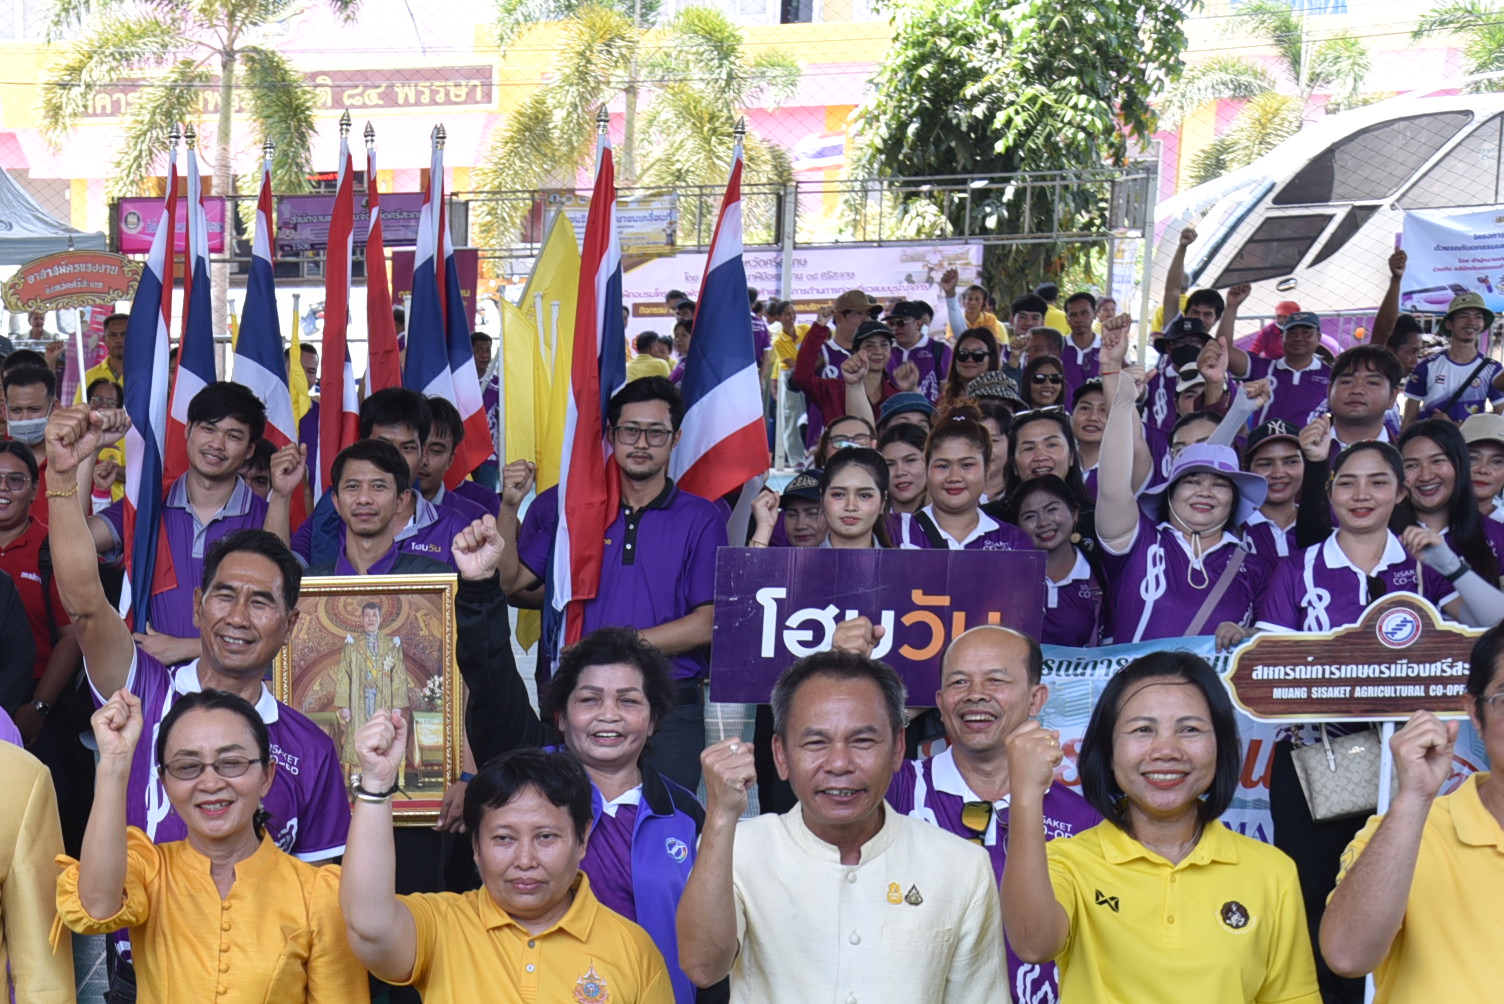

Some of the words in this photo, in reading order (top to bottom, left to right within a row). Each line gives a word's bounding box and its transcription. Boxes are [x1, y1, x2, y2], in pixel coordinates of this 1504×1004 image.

[394, 80, 482, 104] พรรษา
[27, 259, 119, 284] อาสาสมัครแรงงาน
[21, 571, 42, 584] makr
[1251, 656, 1471, 680] สหกรณ์การเกษตรเมืองศรีสะ
[1273, 687, 1307, 699] MUANG
[1311, 686, 1351, 698] SISAKET
[1354, 686, 1425, 698] AGRICULTURAL
